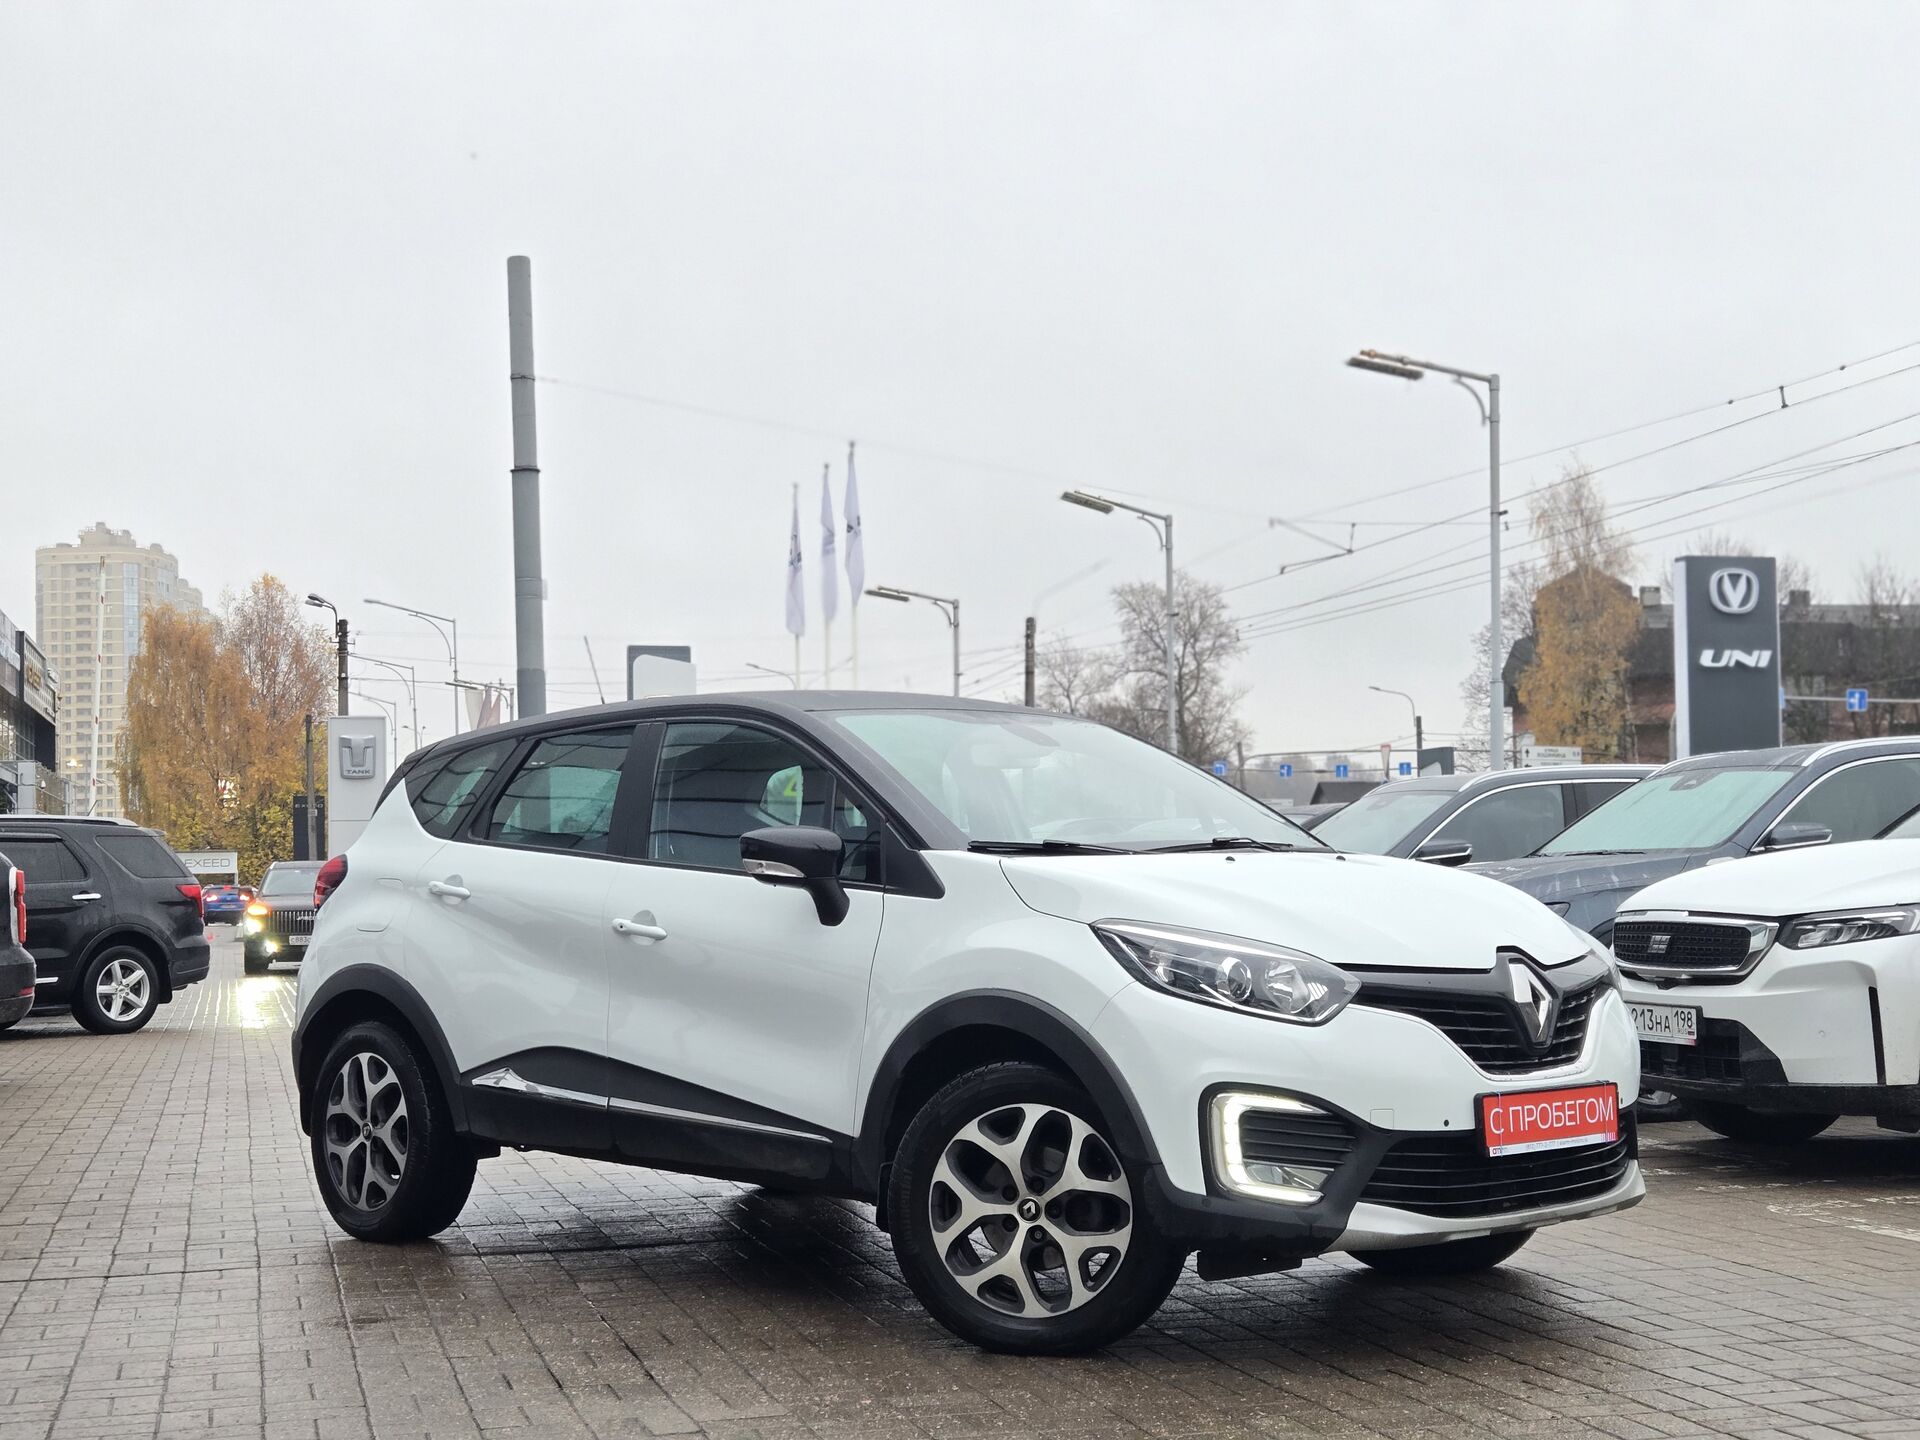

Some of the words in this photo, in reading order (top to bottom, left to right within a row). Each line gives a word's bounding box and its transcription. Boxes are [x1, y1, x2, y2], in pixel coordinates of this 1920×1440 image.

[1699, 649, 1772, 668] UNI
[184, 858, 231, 868] EXEED
[1674, 1009, 1693, 1028] 198
[1489, 1107, 1505, 1134] С
[1509, 1095, 1614, 1133] ПРОБЕГОМ
